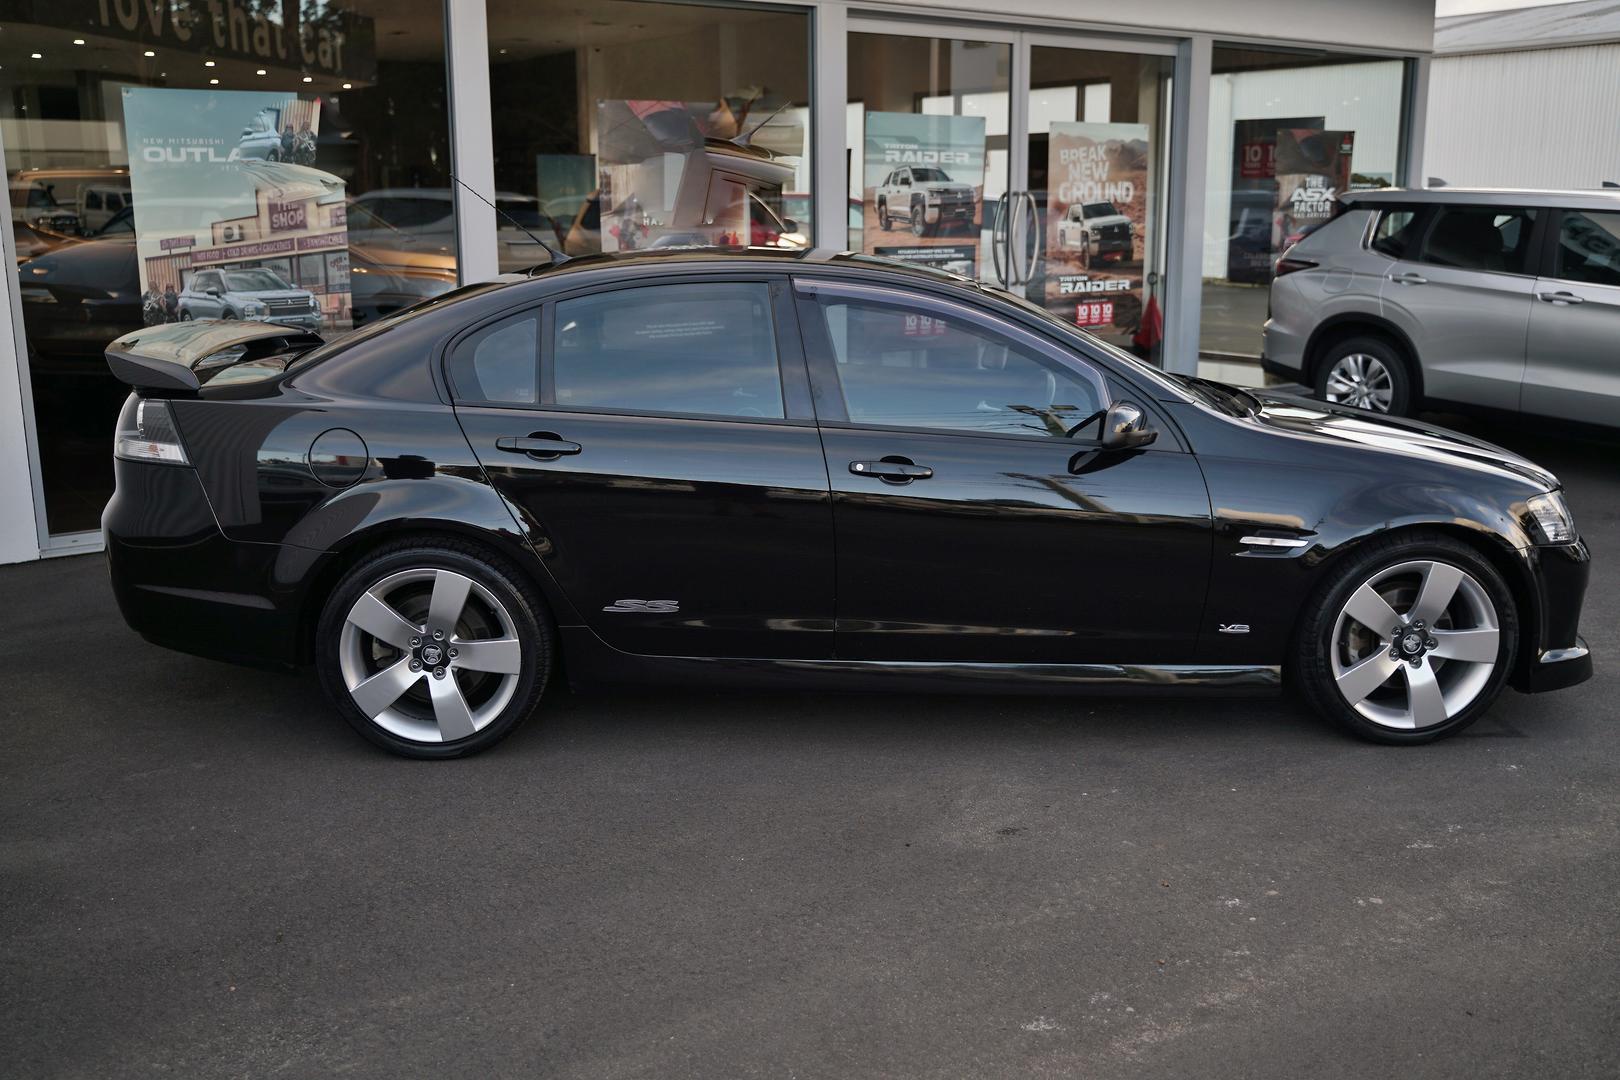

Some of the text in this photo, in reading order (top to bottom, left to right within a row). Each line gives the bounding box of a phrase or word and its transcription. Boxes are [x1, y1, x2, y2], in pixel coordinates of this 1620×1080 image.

[885, 150, 970, 165] RAIDER
[1061, 144, 1106, 164] BREAK
[1244, 145, 1262, 161] 10
[1068, 161, 1110, 181] NEW
[1305, 176, 1323, 188] THE
[1059, 181, 1134, 203] GROUND
[1290, 187, 1336, 202] ASX
[1294, 201, 1331, 212] FACTOR
[272, 209, 304, 228] SHOP
[1060, 280, 1131, 294] RAIDER
[1077, 303, 1113, 316] 10 10 10
[602, 599, 680, 613] SS
